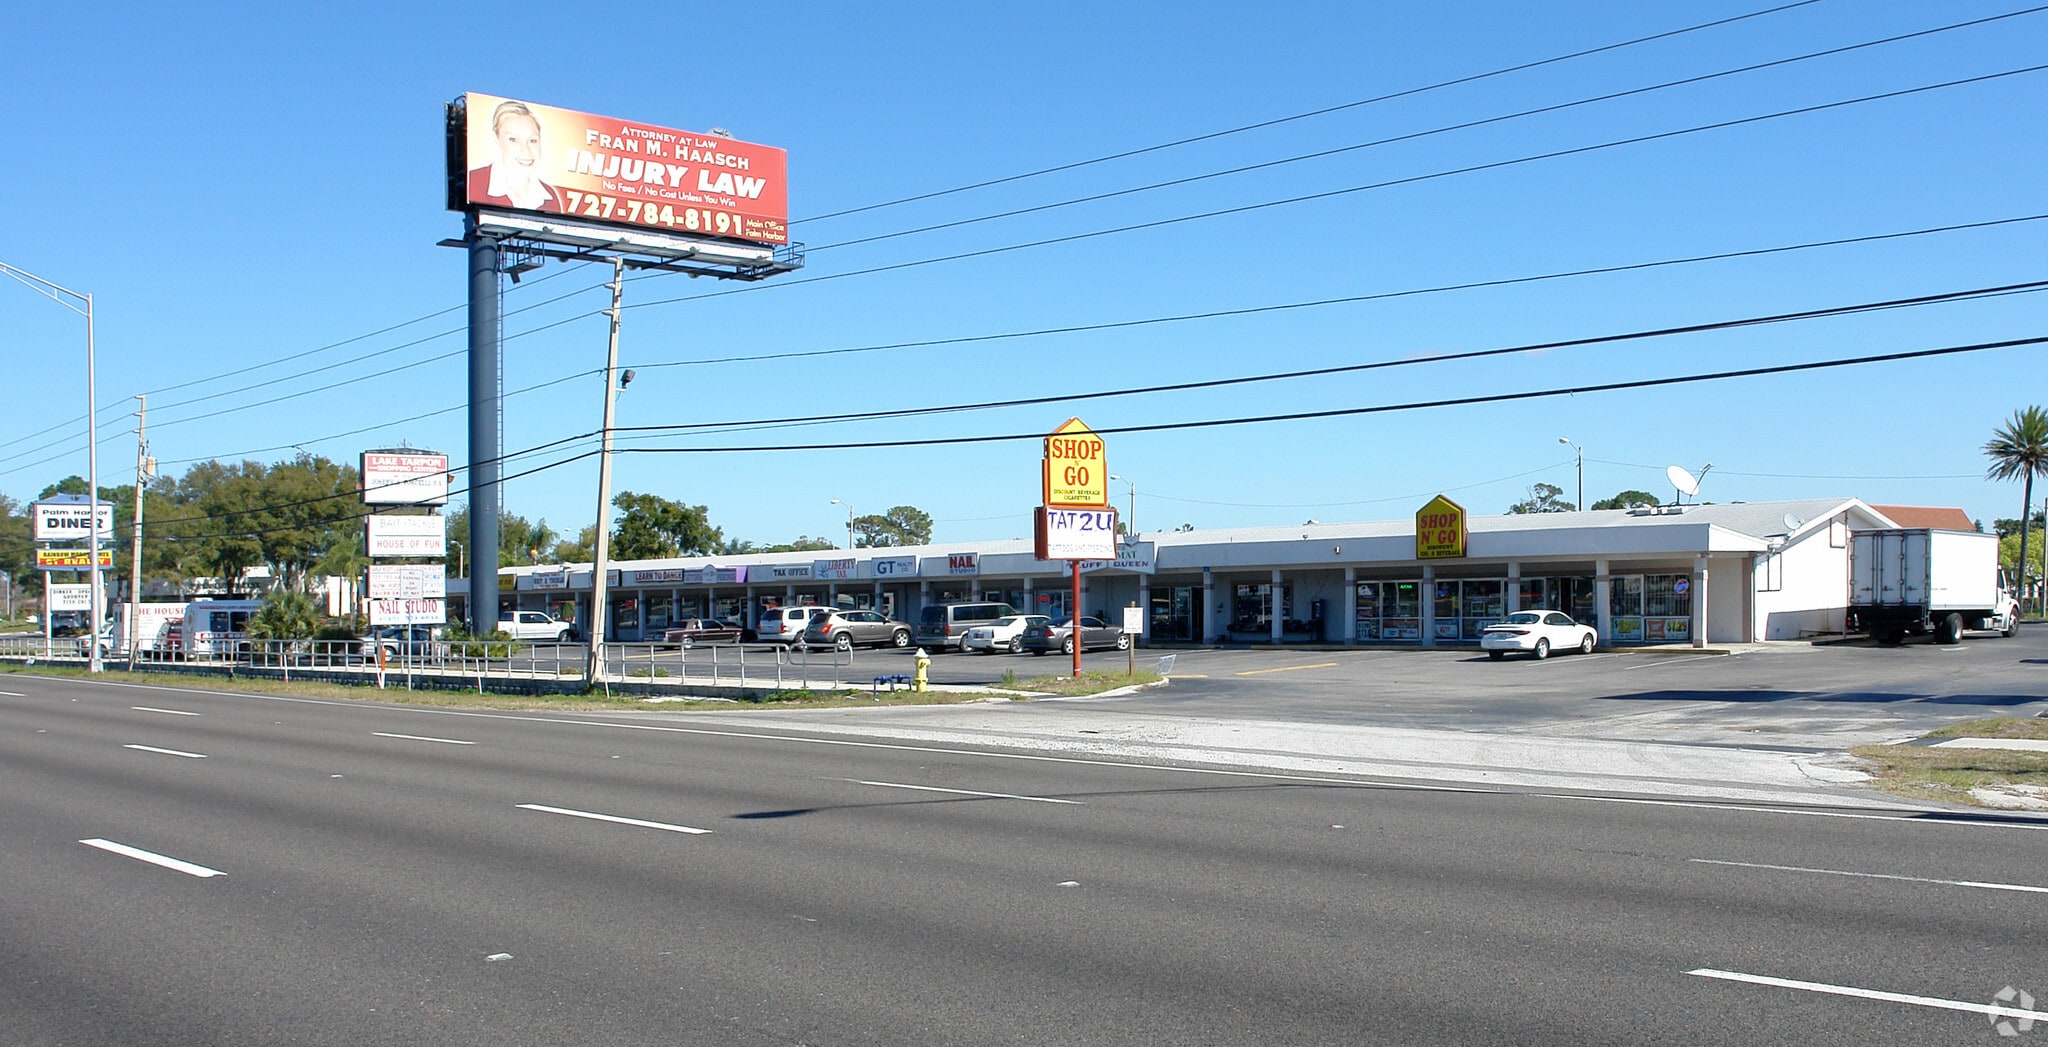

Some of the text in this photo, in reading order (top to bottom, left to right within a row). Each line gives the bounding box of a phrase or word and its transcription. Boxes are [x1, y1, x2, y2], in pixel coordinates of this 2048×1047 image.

[621, 126, 718, 149] ATTORNEY AT LAW
[585, 129, 750, 171] FRAN M. HAASCH
[567, 148, 767, 199] INJURY LAW
[602, 180, 617, 191] No
[617, 183, 636, 194] Fees
[645, 187, 659, 197] No
[659, 189, 677, 199] Cost
[678, 191, 703, 203] Unless
[703, 195, 719, 207] You
[719, 197, 736, 208] Win
[565, 190, 743, 236] 727-784-8191
[745, 218, 764, 229] Main
[763, 230, 786, 242] Harbor
[1052, 438, 1102, 460] SHOP
[371, 456, 442, 469] LAKE TARPON
[1064, 466, 1089, 487] GO
[47, 517, 104, 529] DINER
[1420, 513, 1457, 529] SHOP
[1437, 529, 1457, 544] GO
[376, 540, 441, 548] HOUSE OF FUN
[826, 559, 855, 570] LIBERTY
[877, 560, 896, 575] GT
[949, 555, 976, 569] NAIL
[635, 570, 653, 581] LEARN
[654, 570, 663, 580] TO
[663, 569, 682, 580] DANCE
[773, 567, 809, 576] TAX OFFICE
[836, 570, 847, 578] TAX
[138, 607, 152, 615] HE
[379, 599, 438, 614] NAIL STUDIO
